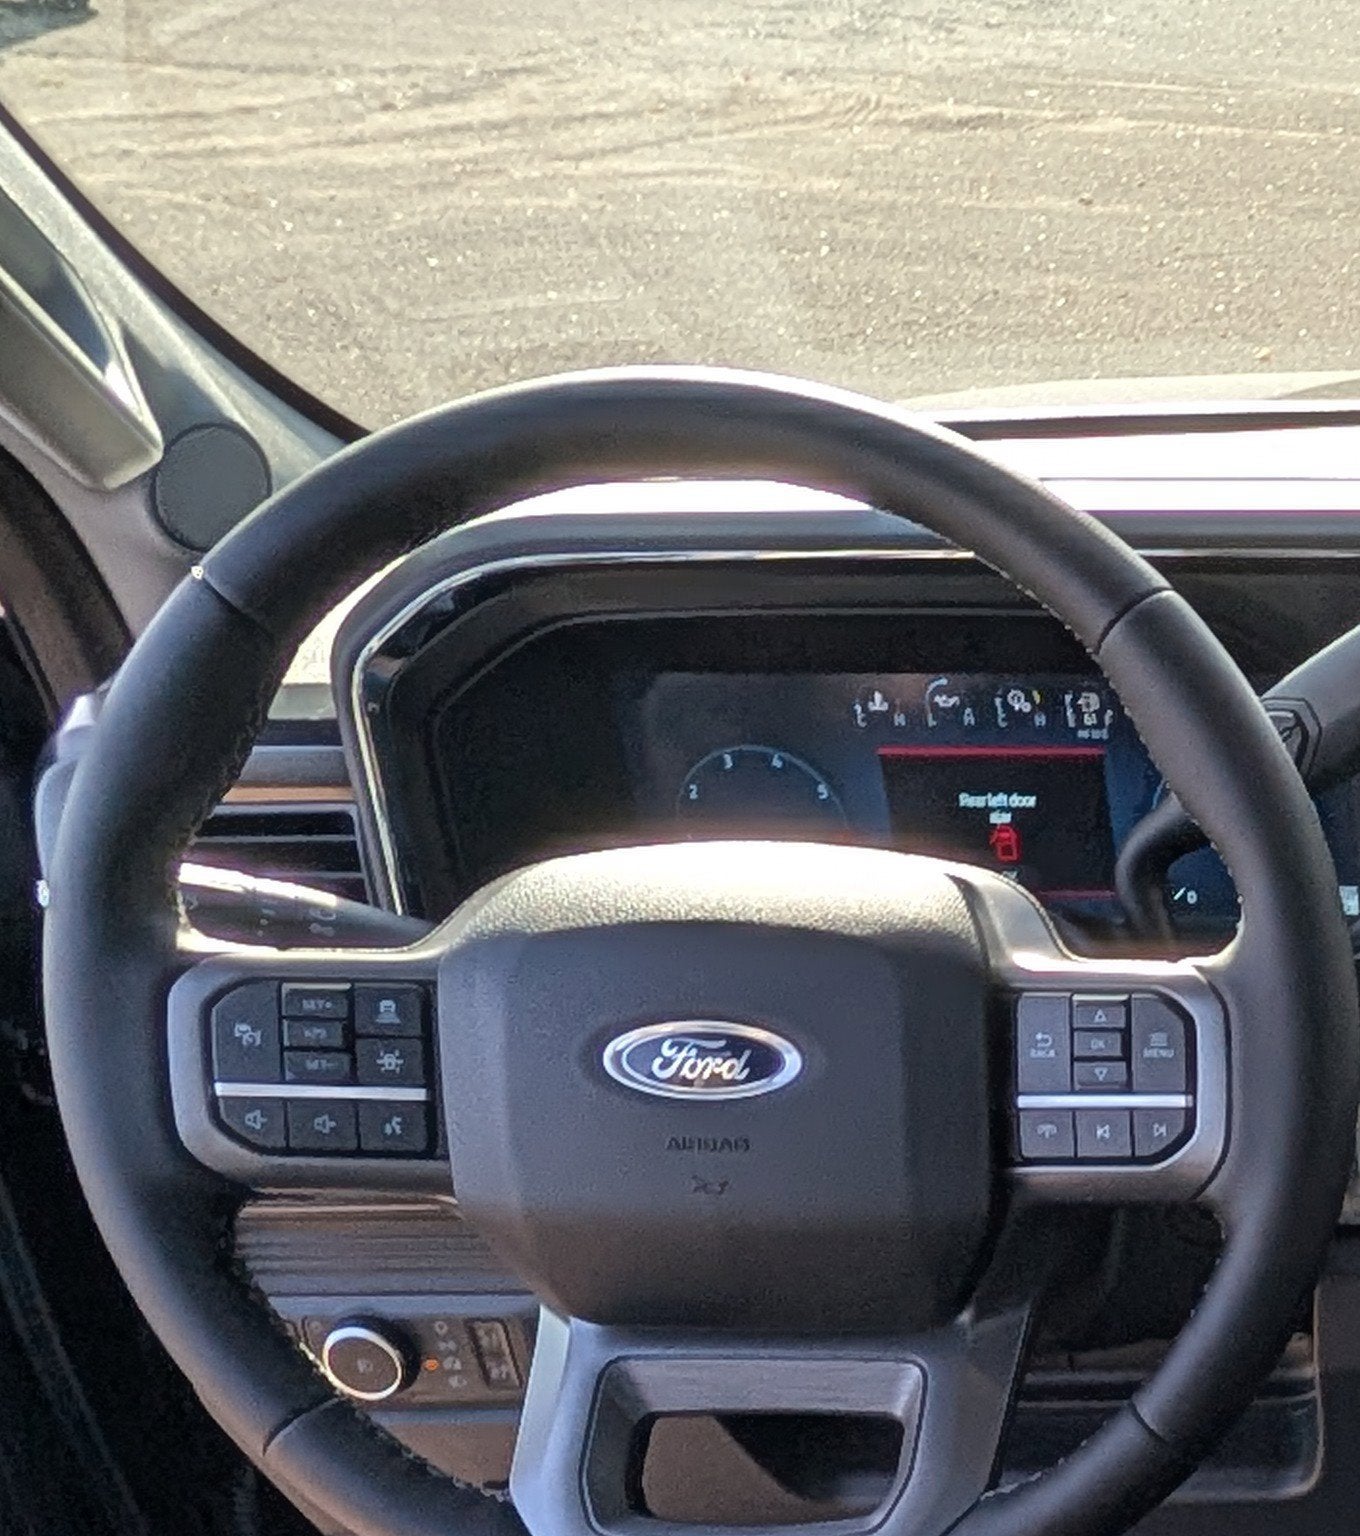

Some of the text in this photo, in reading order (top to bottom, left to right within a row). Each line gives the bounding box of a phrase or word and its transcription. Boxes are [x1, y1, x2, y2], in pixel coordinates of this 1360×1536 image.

[688, 784, 698, 799] 2
[816, 784, 829, 800] 5
[652, 1039, 751, 1086] Ford
